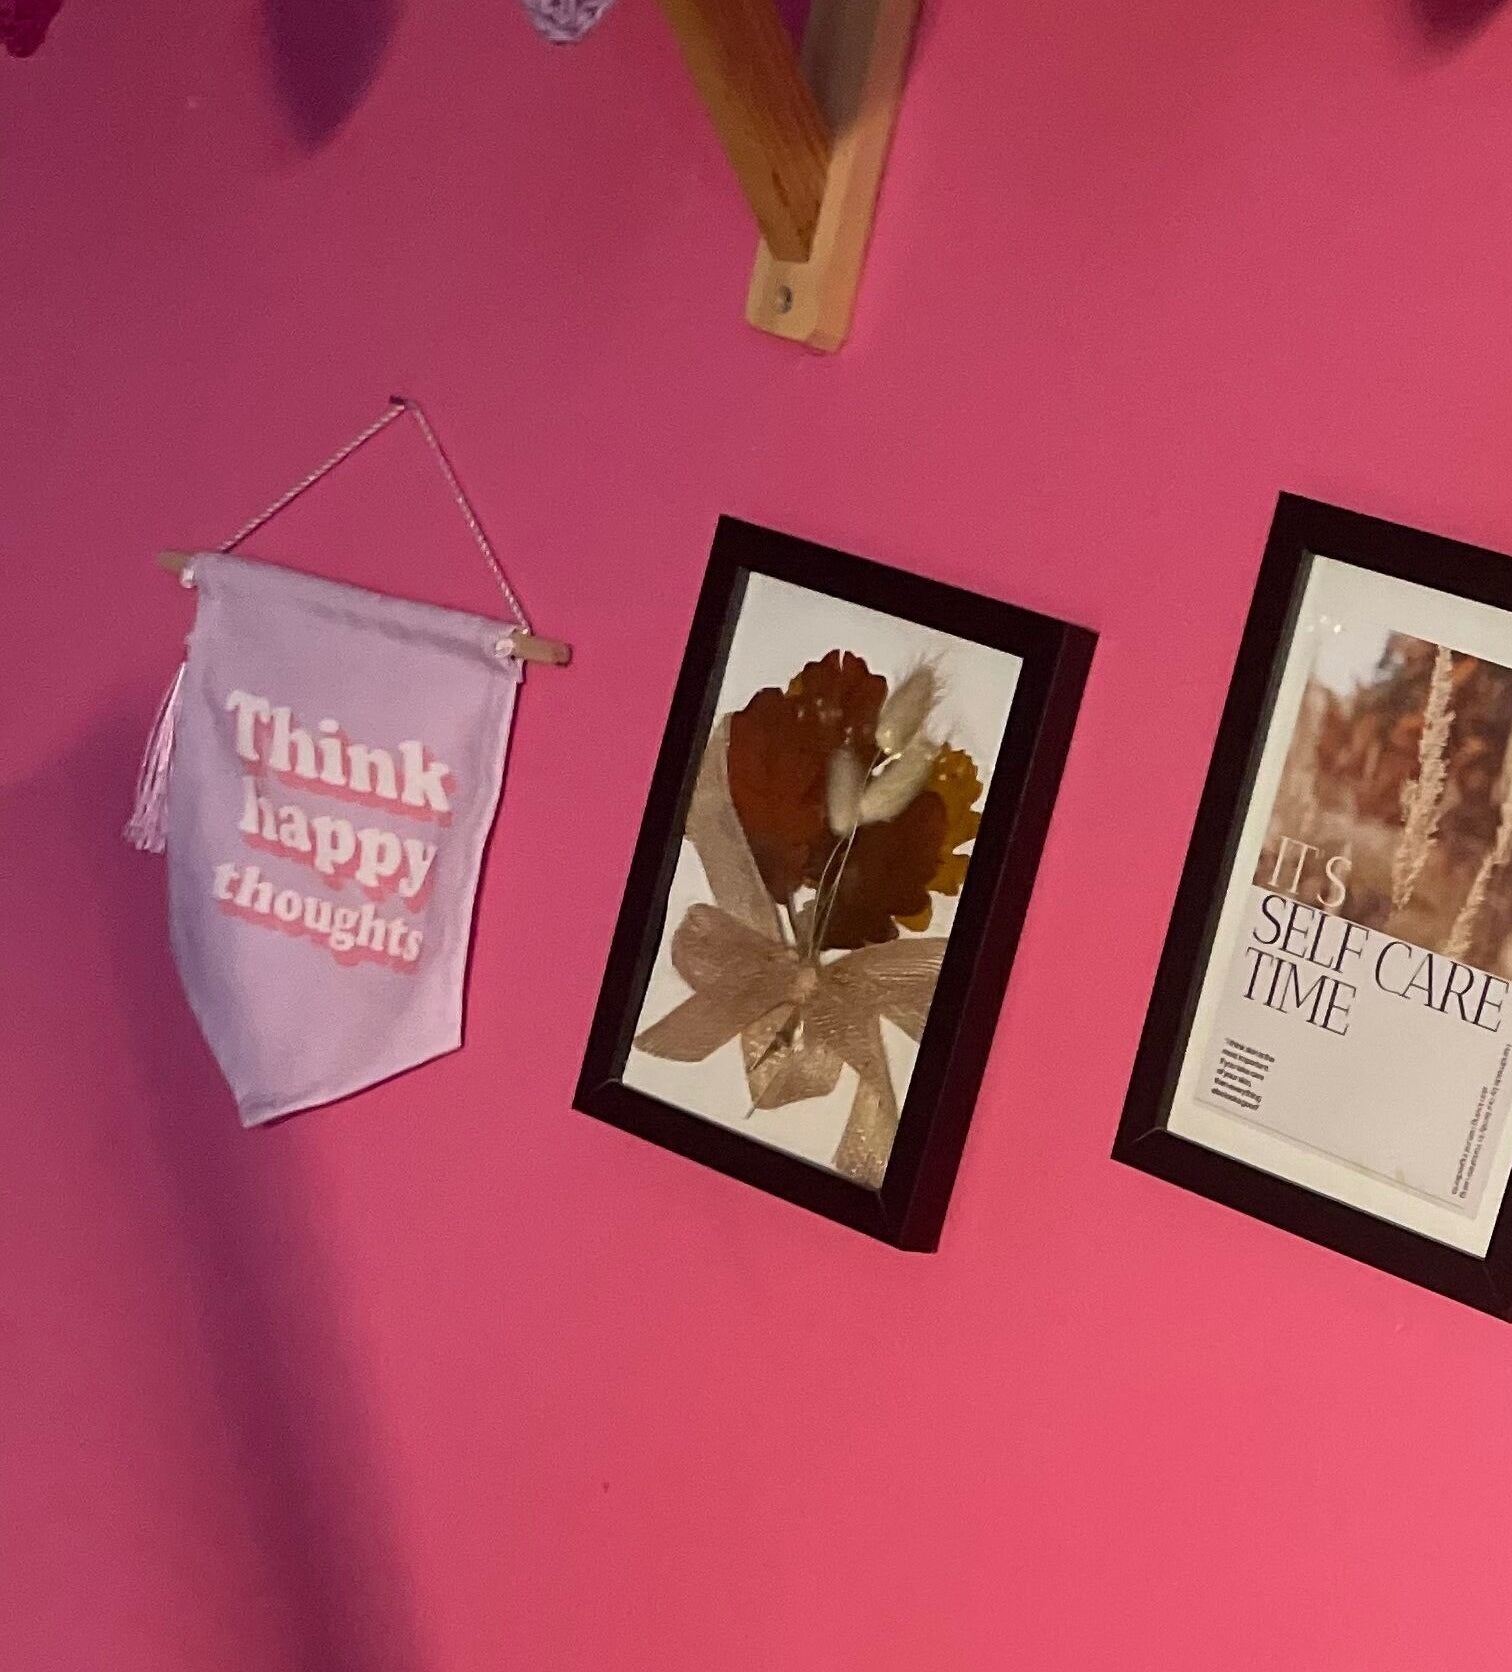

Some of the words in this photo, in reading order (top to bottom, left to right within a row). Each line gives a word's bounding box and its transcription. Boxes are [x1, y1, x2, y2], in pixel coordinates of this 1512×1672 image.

[225, 689, 453, 813] Think
[238, 774, 438, 898] happy
[212, 862, 424, 962] thoughts
[1252, 893, 1370, 974] SELF
[1374, 940, 1511, 1034] CARE
[1243, 947, 1358, 1037] TIME
